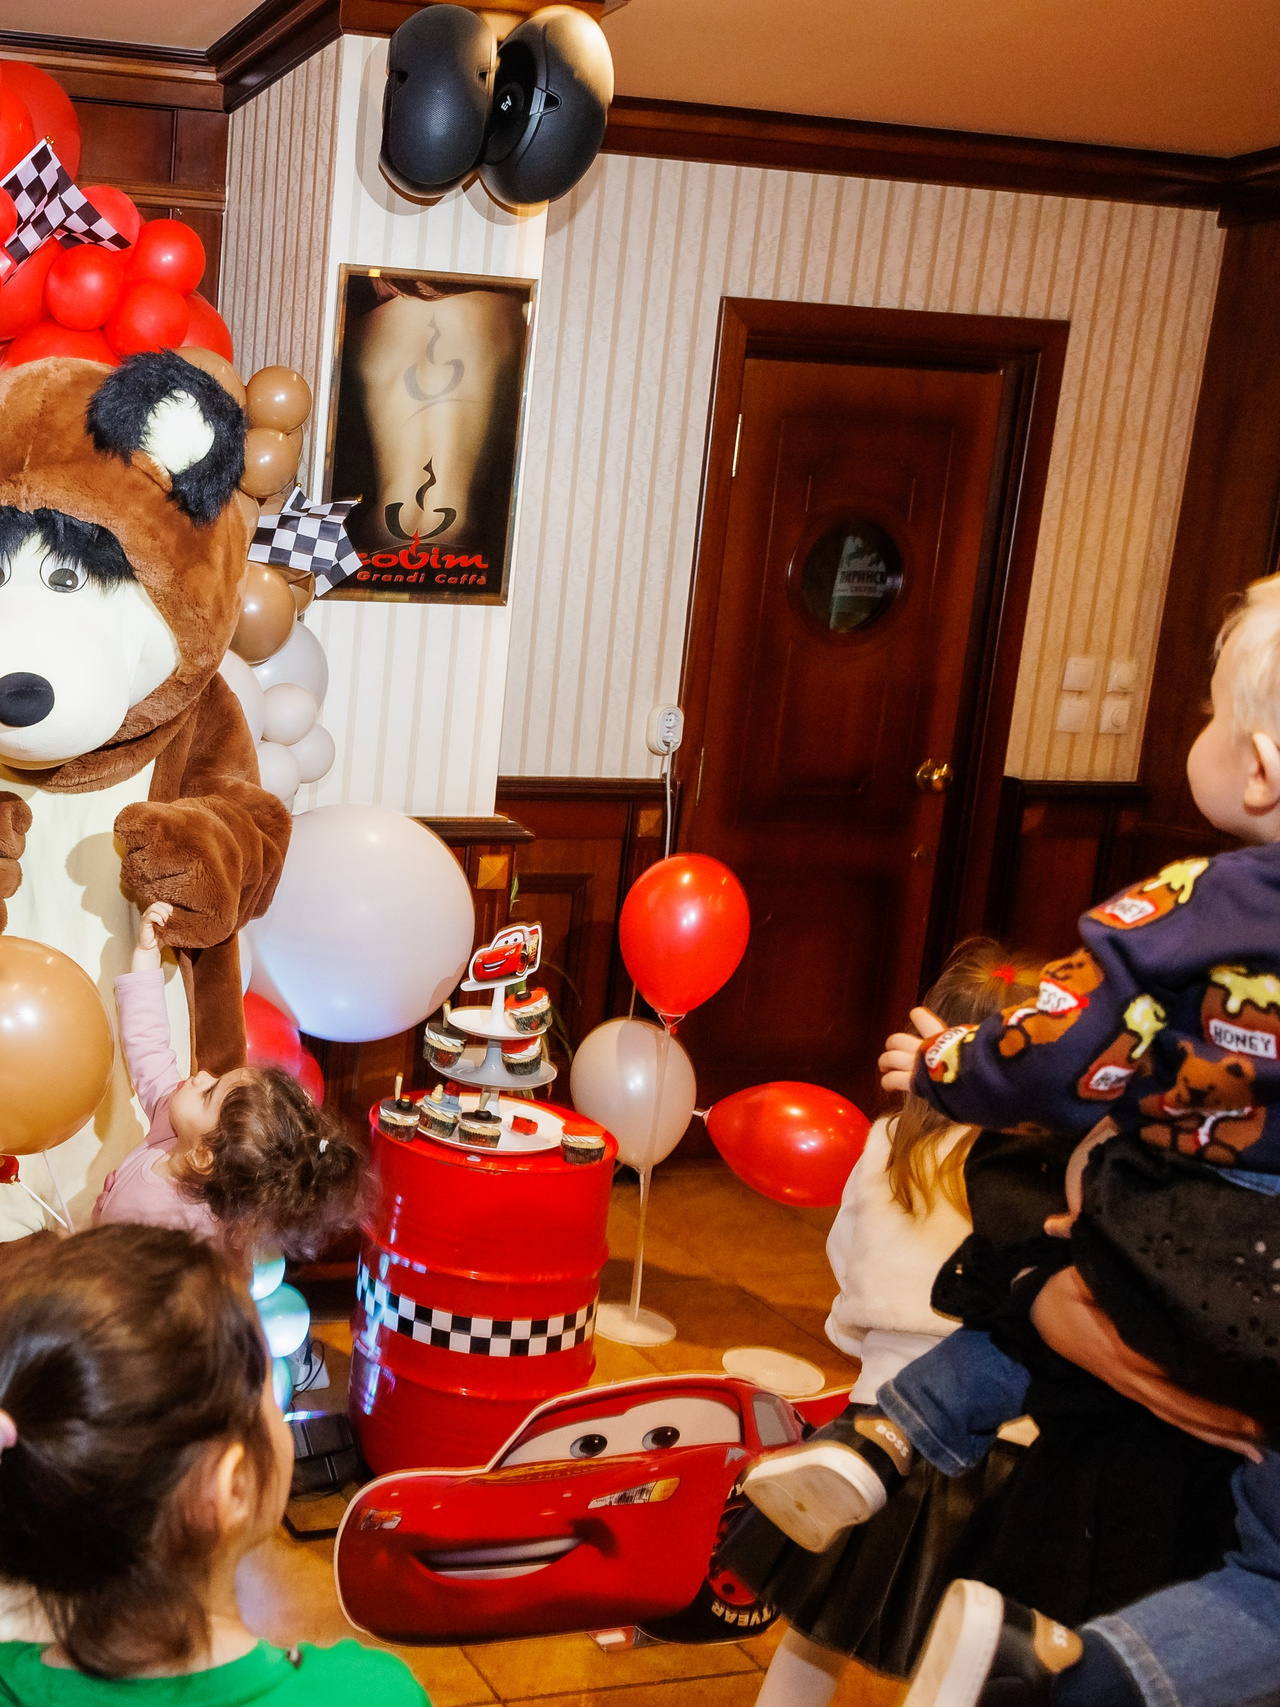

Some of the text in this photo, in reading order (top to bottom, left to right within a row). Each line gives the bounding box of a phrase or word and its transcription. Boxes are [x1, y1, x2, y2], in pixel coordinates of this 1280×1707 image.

[500, 95, 512, 111] EV
[357, 570, 426, 584] Grandi
[1212, 1026, 1272, 1052] HONEY
[875, 1424, 909, 1457] BOSS
